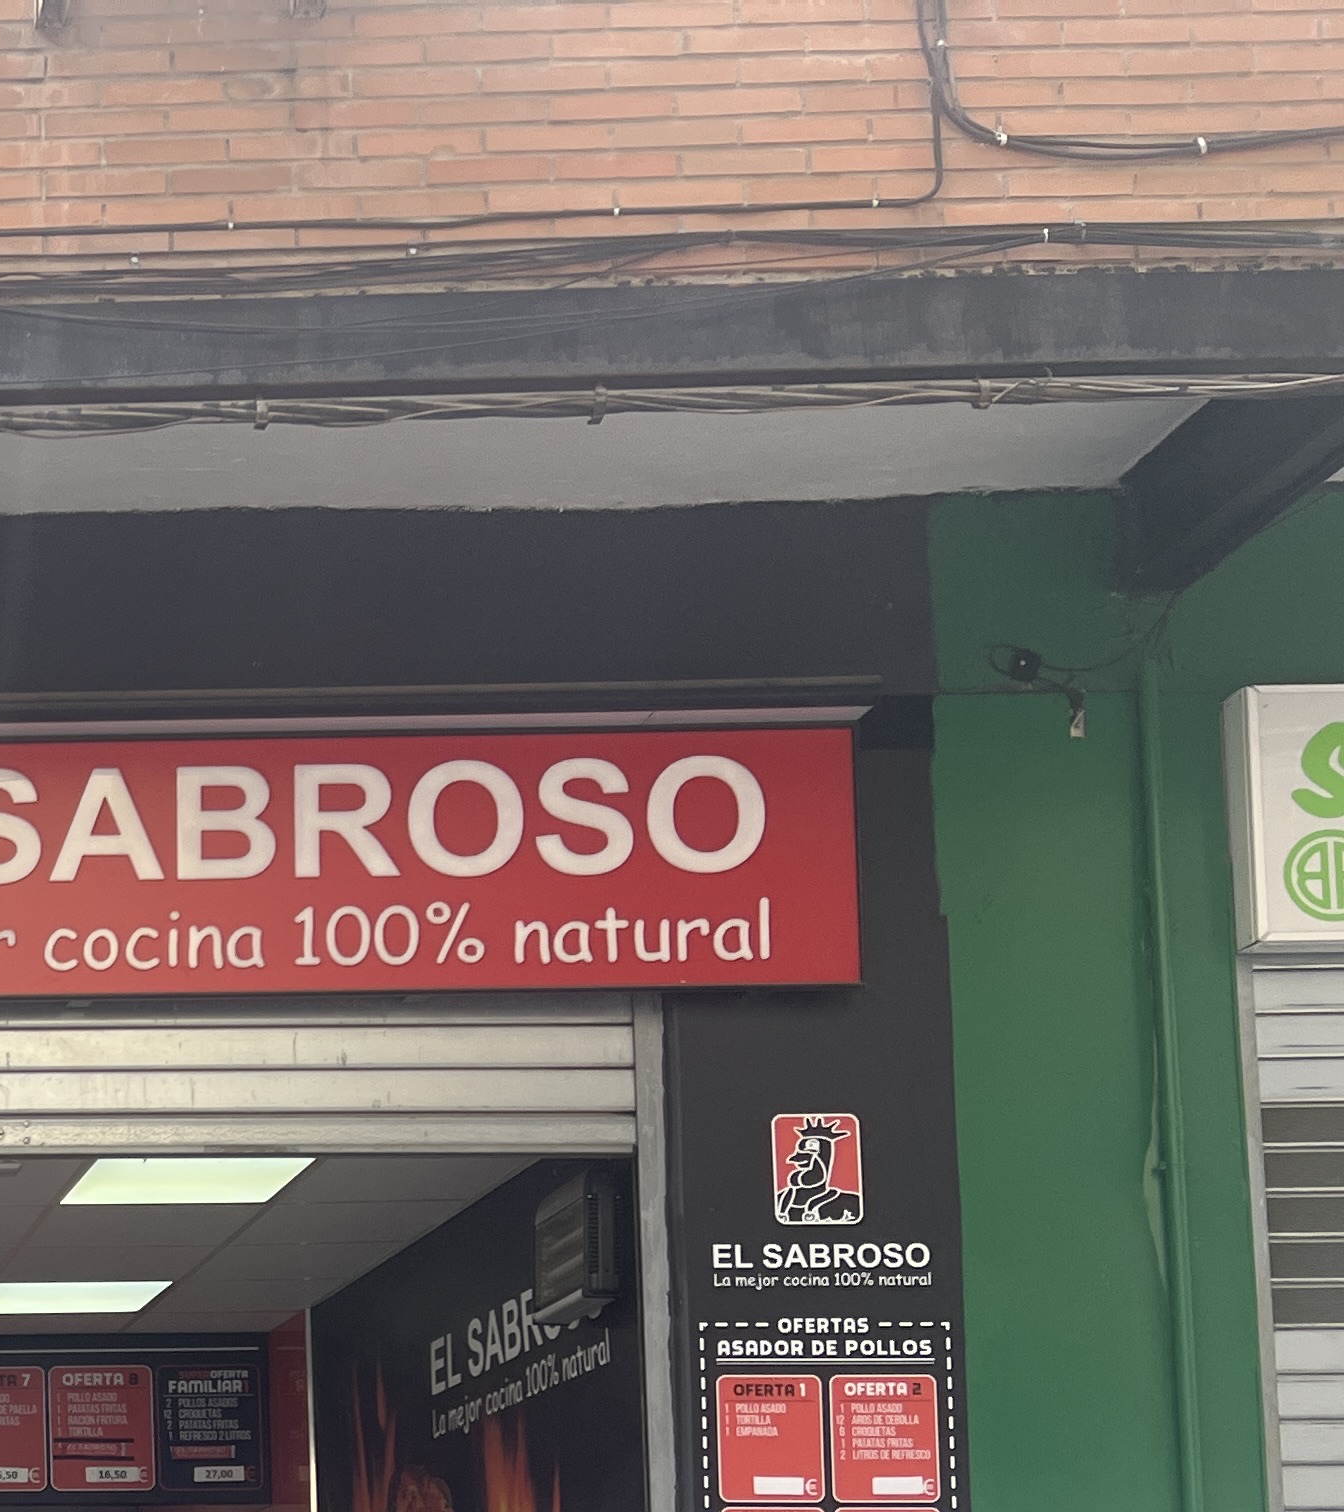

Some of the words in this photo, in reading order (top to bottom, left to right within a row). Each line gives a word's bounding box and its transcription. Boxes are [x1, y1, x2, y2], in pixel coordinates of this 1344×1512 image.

[43, 910, 266, 972] cocina
[294, 902, 484, 966] 100%
[514, 895, 772, 966] natural
[712, 1244, 754, 1269] EL
[763, 1243, 931, 1269] SABROSO
[713, 1274, 731, 1287] La
[735, 1273, 779, 1290] mejor
[783, 1272, 829, 1287] cocina
[834, 1272, 874, 1286] 100%
[878, 1272, 932, 1286] natural
[778, 1318, 869, 1334] OFERTAS
[717, 1340, 804, 1356] ASADOR
[812, 1340, 837, 1356] DE
[845, 1340, 932, 1356] POLLOS
[430, 1333, 461, 1396] EL
[21, 1374, 31, 1388] 7
[62, 1373, 124, 1387] OFERTA
[129, 1373, 139, 1387] 8
[432, 1409, 446, 1439] La
[448, 1394, 482, 1434] mejor
[485, 1377, 523, 1416] cocina
[525, 1353, 560, 1397] 100%
[562, 1328, 610, 1383] natural
[733, 1383, 795, 1397] OFERTA
[799, 1383, 806, 1397] 1
[844, 1382, 907, 1396] OFERTA
[912, 1382, 921, 1396] 2
